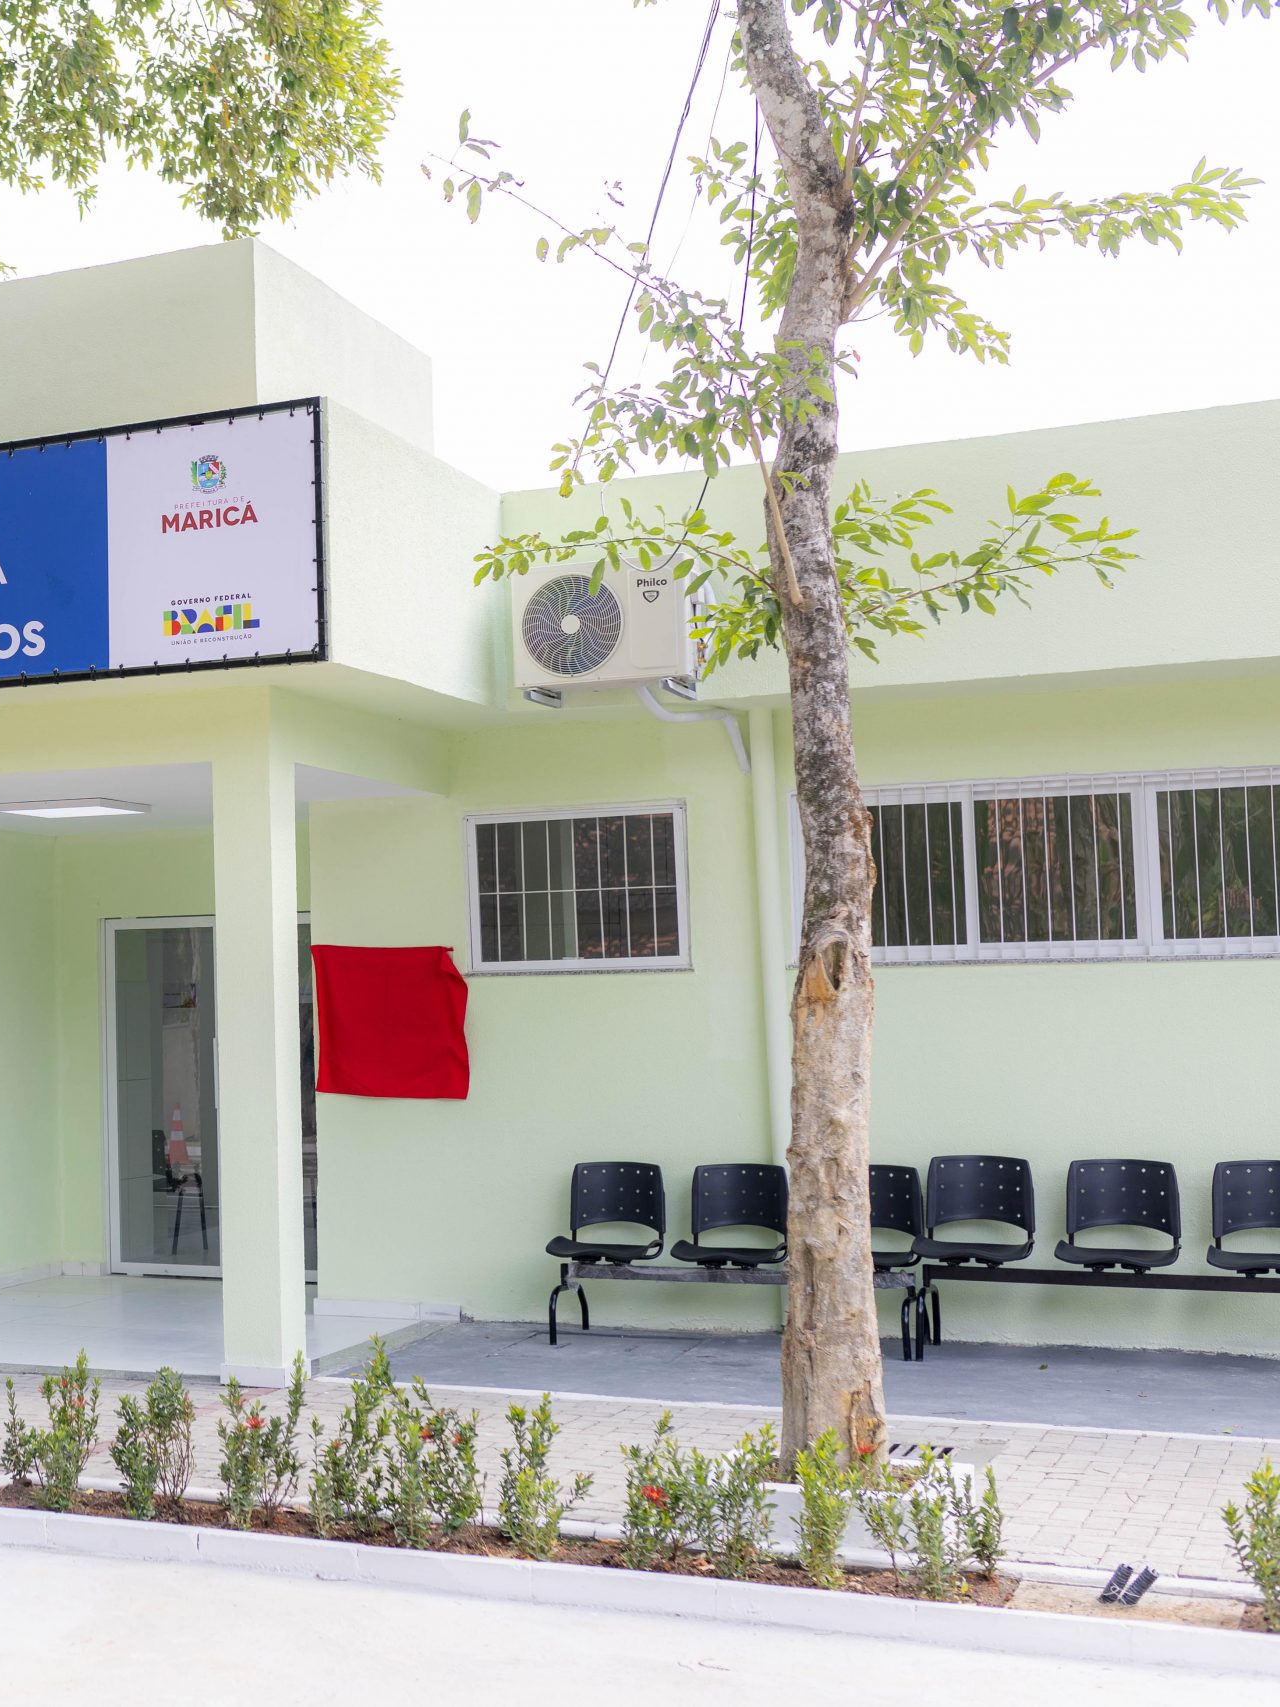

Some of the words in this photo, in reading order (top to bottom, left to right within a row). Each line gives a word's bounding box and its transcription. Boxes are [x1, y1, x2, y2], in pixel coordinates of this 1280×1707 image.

[174, 499, 229, 510] PREFEITURA
[161, 500, 258, 533] MARICÁ
[637, 578, 667, 587] Philco
[171, 597, 210, 605] GOVERNO
[214, 593, 251, 601] FEDERAL
[163, 602, 260, 637] BRASIL
[200, 633, 252, 643] RECONSTRUÇÃO
